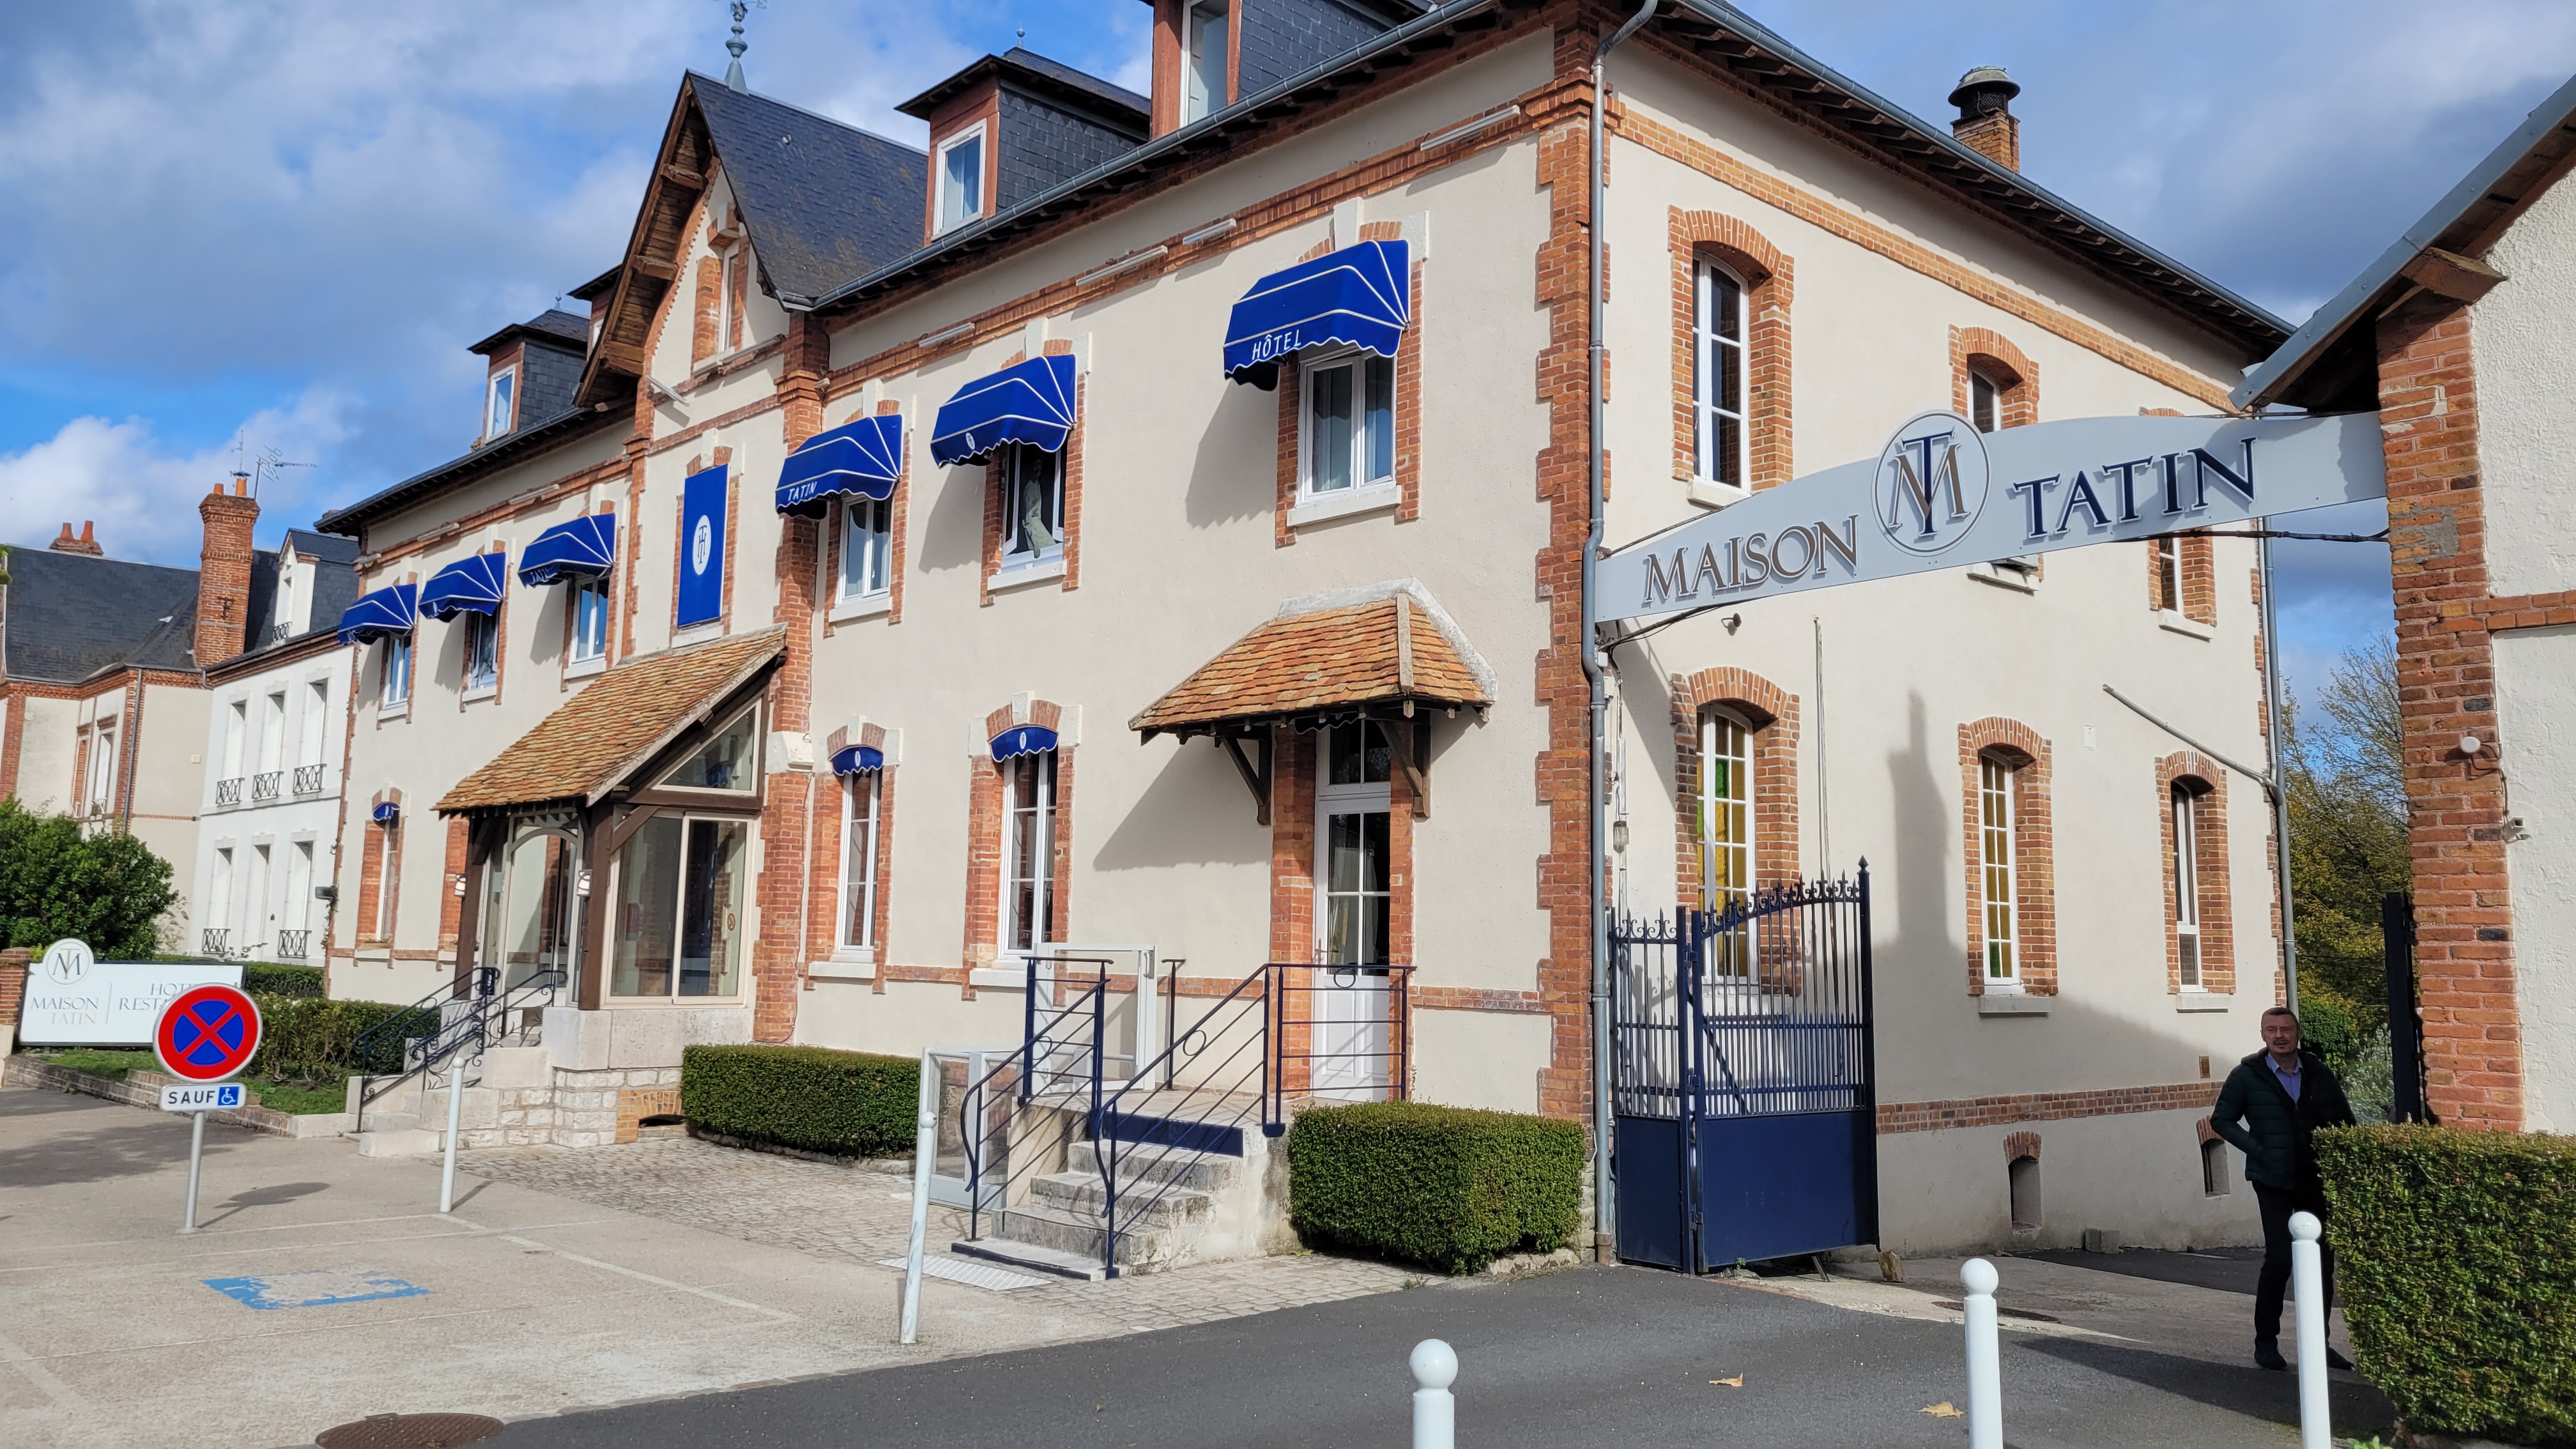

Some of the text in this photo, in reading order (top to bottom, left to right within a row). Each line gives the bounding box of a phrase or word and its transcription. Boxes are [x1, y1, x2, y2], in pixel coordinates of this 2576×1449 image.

[1251, 329, 1301, 361] HÔTEL
[788, 480, 818, 502] TATIN
[1644, 436, 2258, 603] MAISON TATIN
[150, 982, 195, 996] HOT
[31, 997, 99, 1010] MAISON
[119, 997, 164, 1011] REST
[50, 1012, 96, 1025] TATIN
[167, 1090, 216, 1105] SAUF
